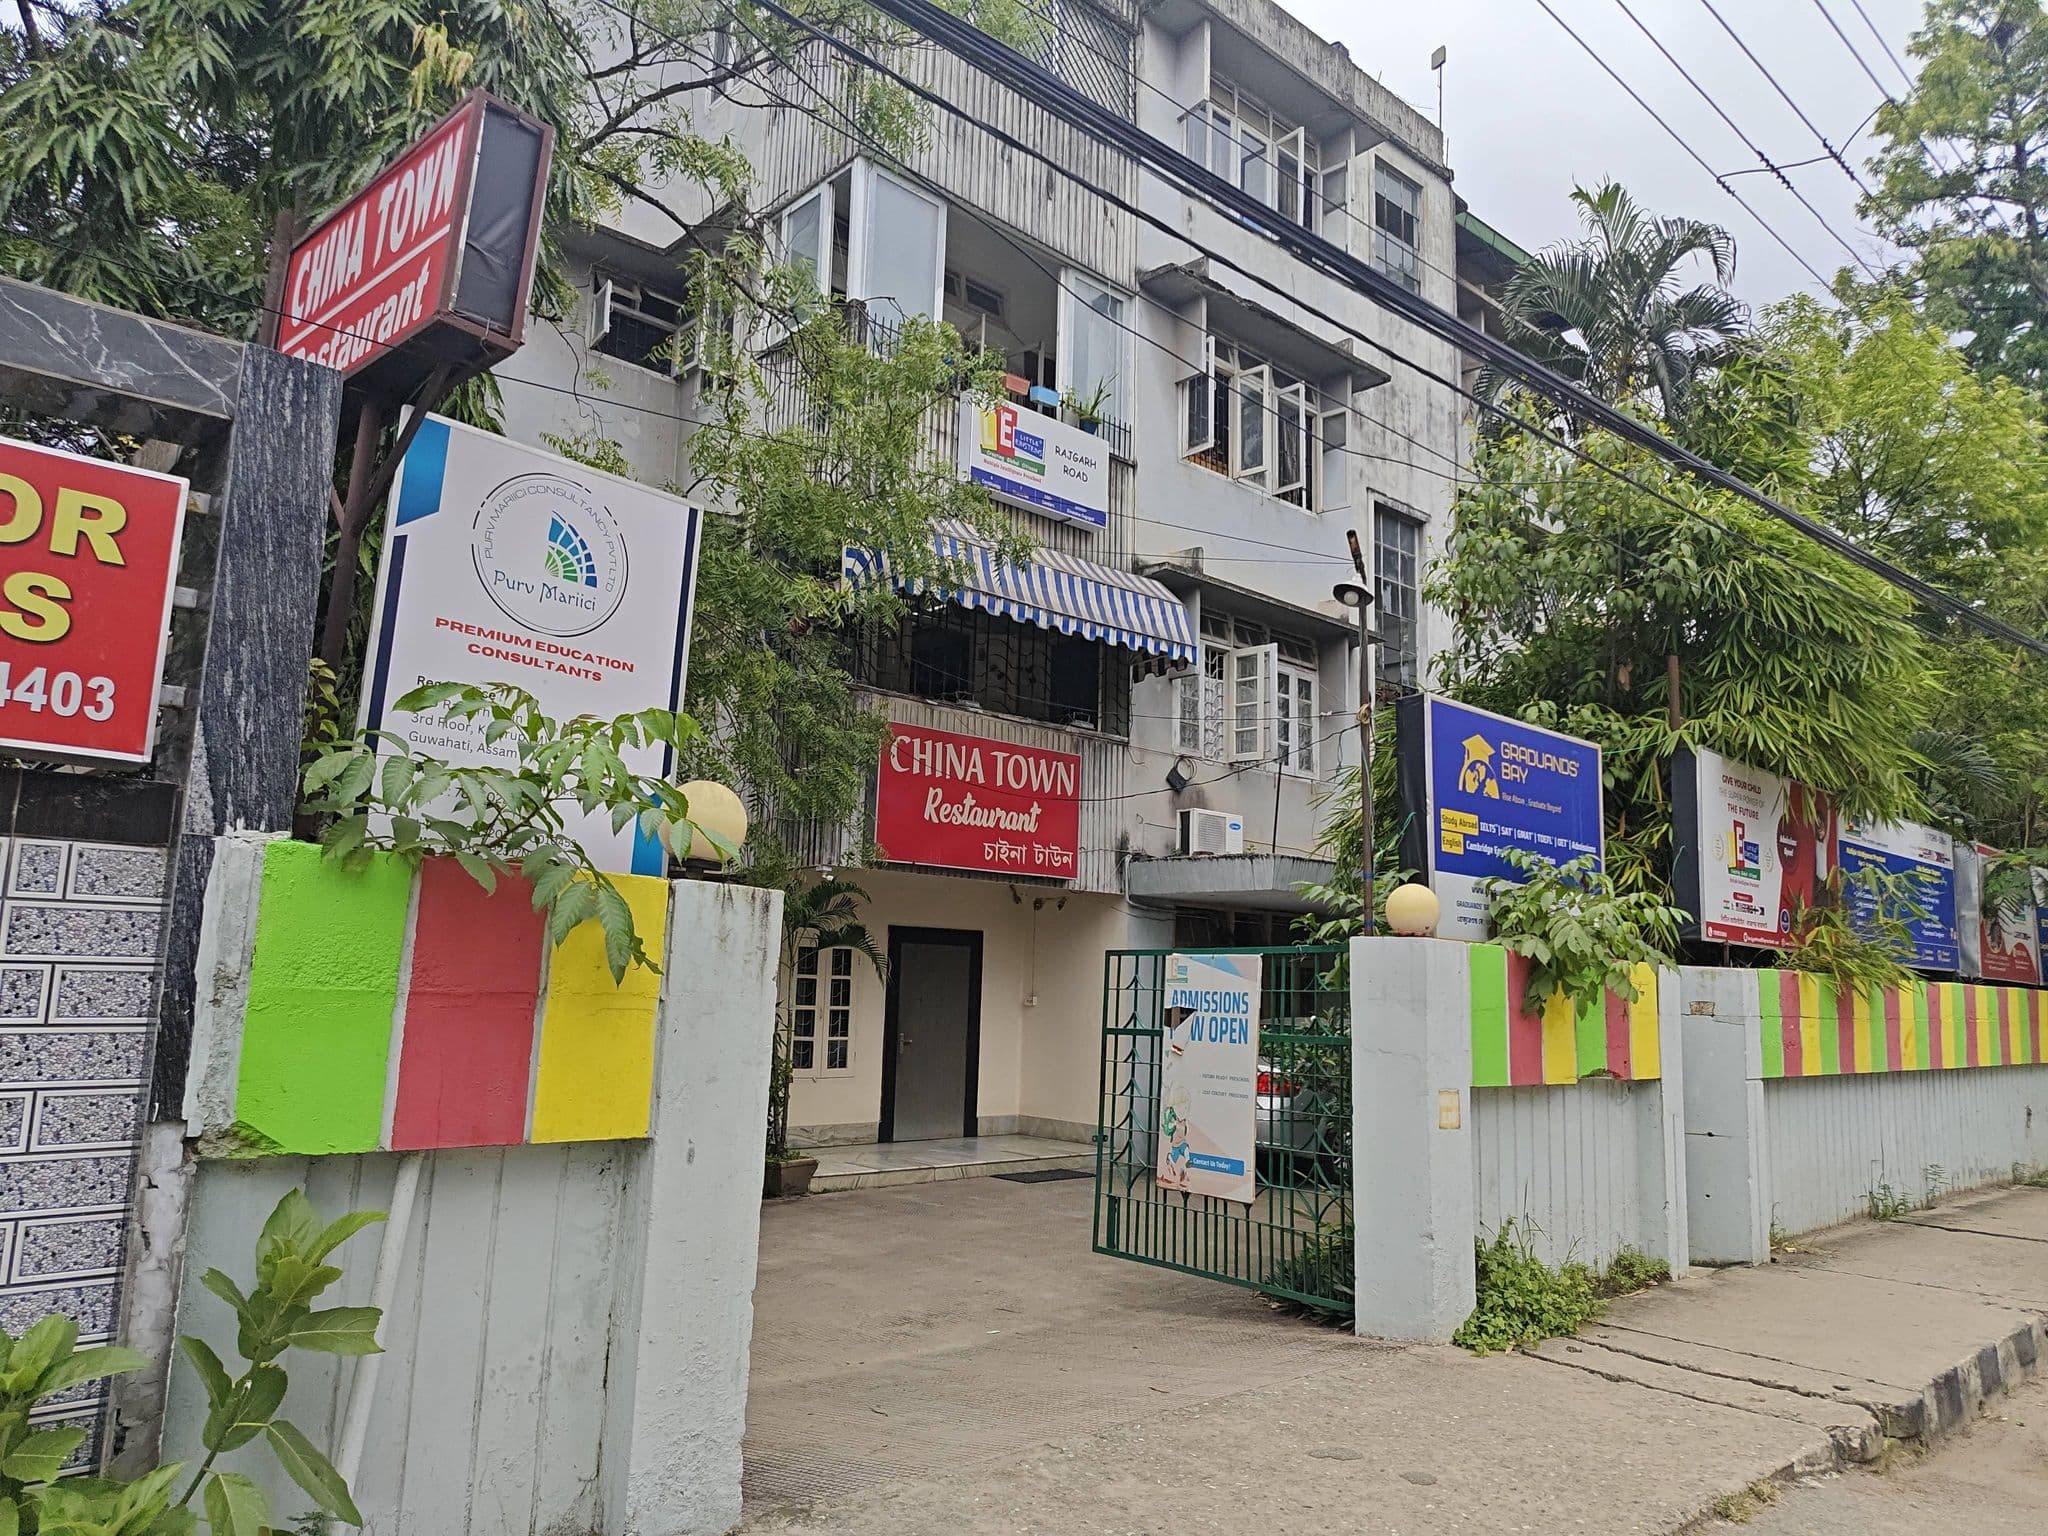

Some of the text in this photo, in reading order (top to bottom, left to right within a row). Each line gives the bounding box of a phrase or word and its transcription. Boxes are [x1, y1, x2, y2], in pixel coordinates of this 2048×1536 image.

[291, 123, 465, 327] CHINA TOWN
[1055, 445, 1097, 470] RAJGARH
[1063, 464, 1089, 483] ROAD
[485, 521, 496, 559] PURV
[528, 485, 610, 538] CONSULTANCY
[493, 569, 596, 611] Purv Mariici
[435, 617, 635, 673] PREMIUM EDUCATION
[467, 643, 602, 682] CONSULTANTS
[411, 712, 434, 726] 3rd
[408, 730, 517, 758] Guwahati, Assam
[890, 735, 1074, 797] CHINA TOWN
[1502, 763, 1529, 785] BAY
[1747, 783, 1762, 795] CHILD
[924, 787, 1042, 833] Restaurant
[1441, 814, 1478, 830] Study Abroad
[1727, 803, 1760, 820] THE FUTURE
[982, 837, 1074, 870] চাইনা টাউন
[1442, 836, 1463, 849] English
[1171, 989, 1249, 1015] ADMISSIONS
[1208, 1016, 1249, 1045] OPEN
